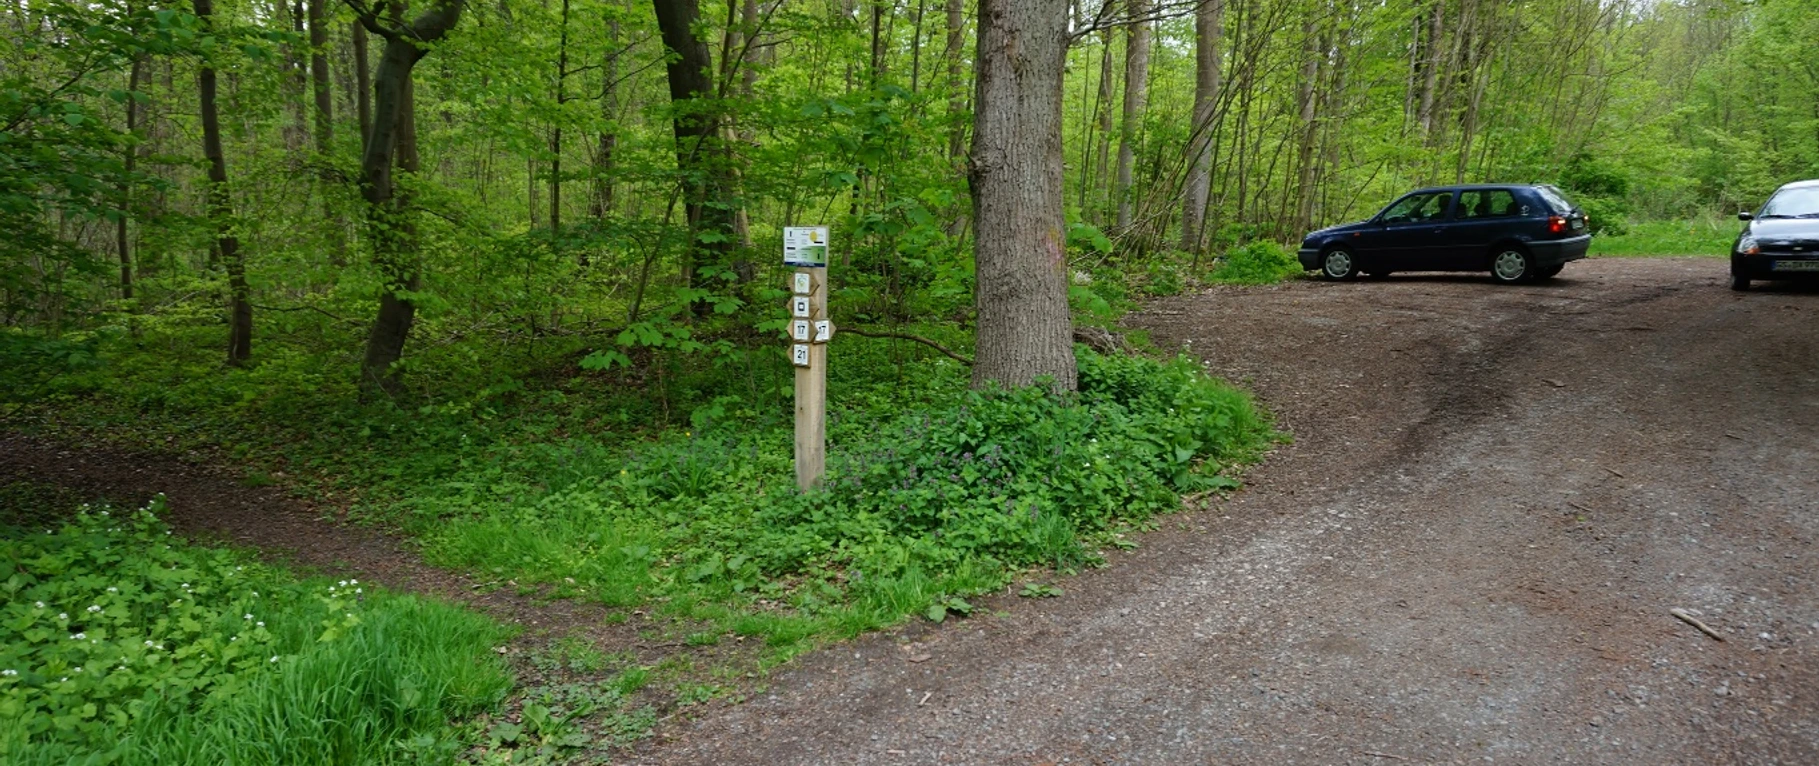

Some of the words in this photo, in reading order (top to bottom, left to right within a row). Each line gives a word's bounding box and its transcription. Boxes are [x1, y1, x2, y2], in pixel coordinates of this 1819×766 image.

[797, 325, 805, 334] 17
[818, 325, 826, 334] 17
[797, 349, 806, 360] 21
